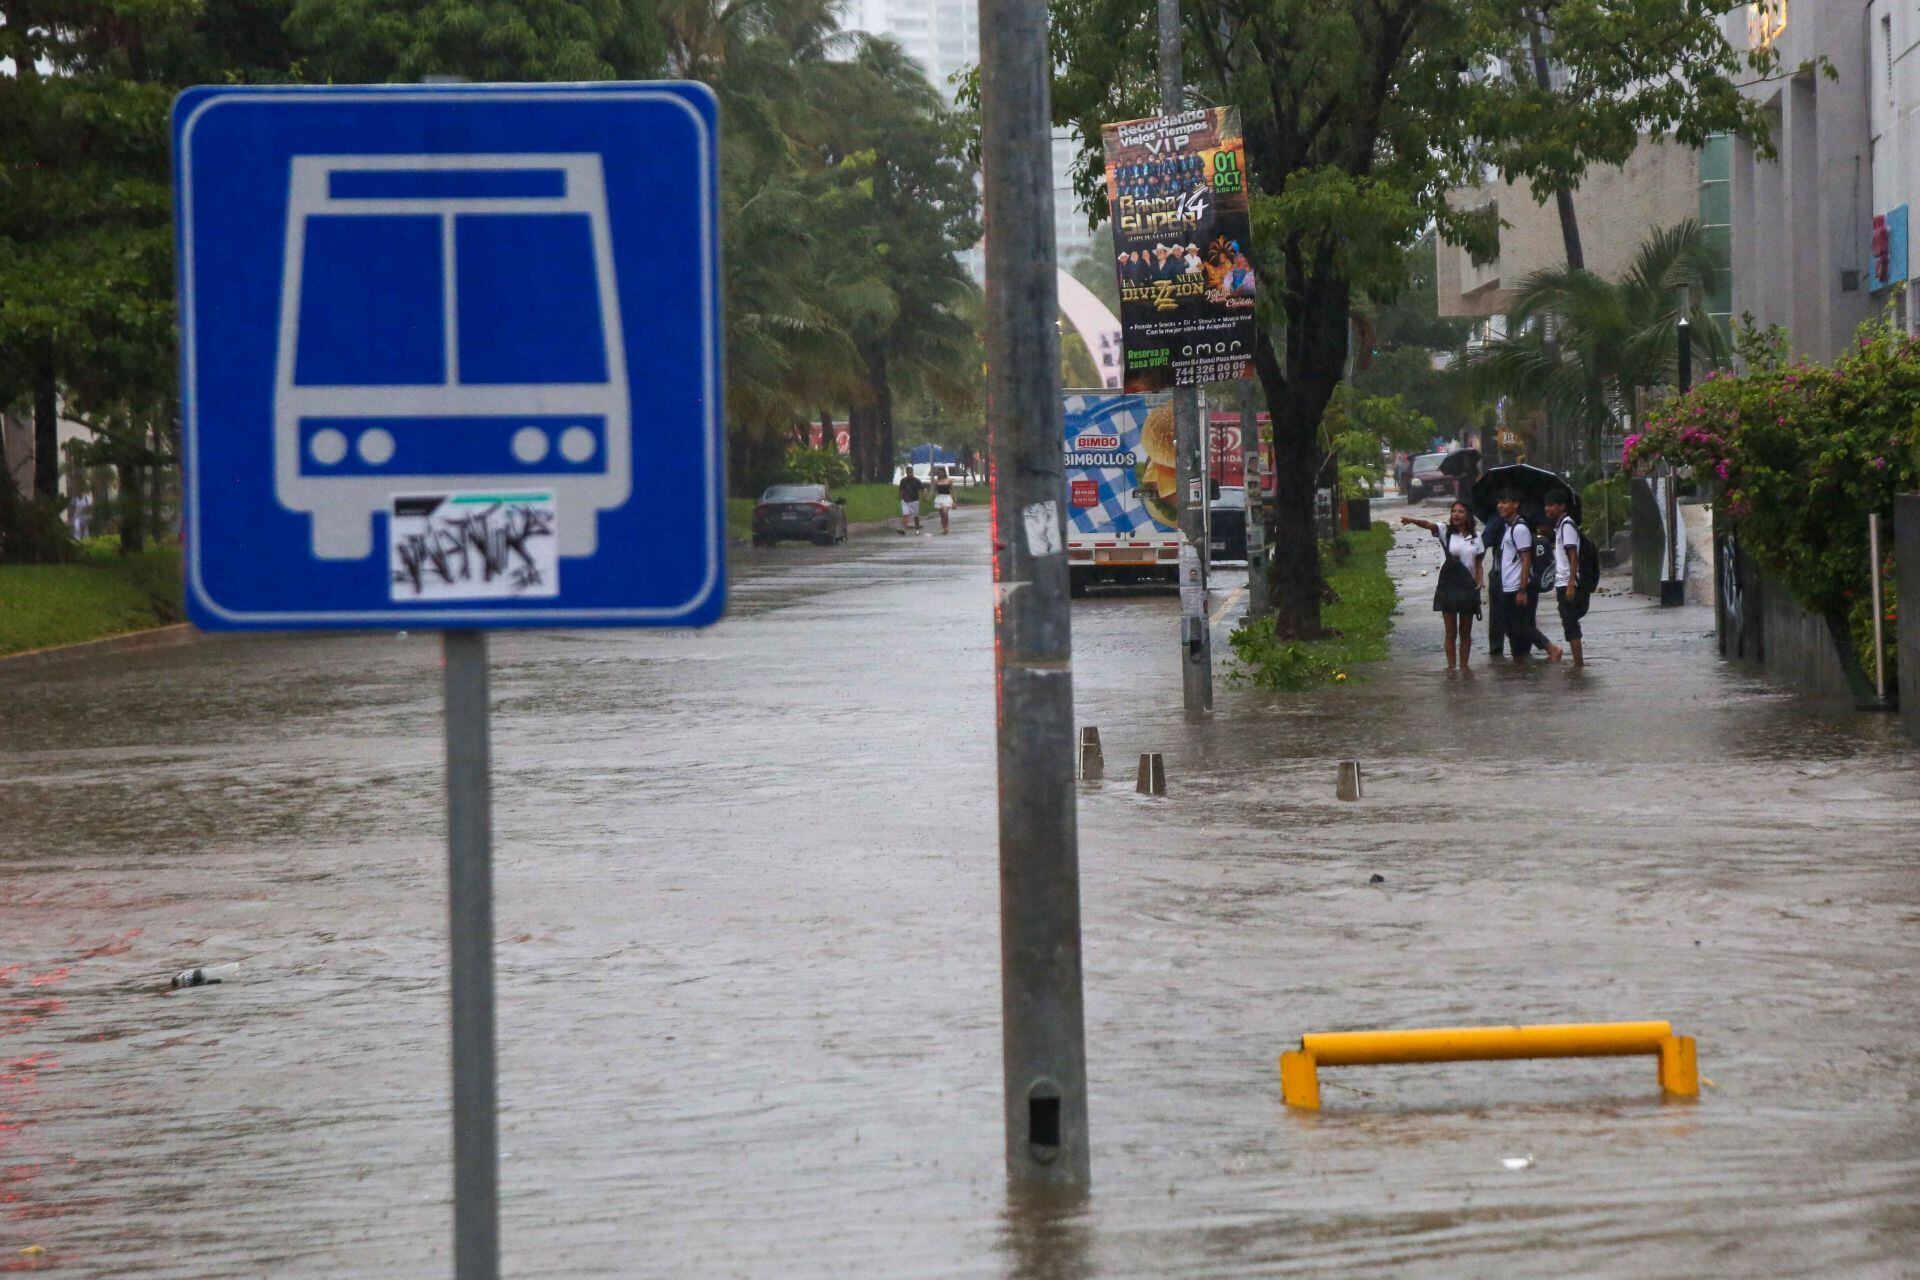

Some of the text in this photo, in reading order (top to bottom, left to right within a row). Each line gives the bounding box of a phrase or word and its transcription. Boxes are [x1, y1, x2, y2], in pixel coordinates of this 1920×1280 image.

[1118, 110, 1206, 138] Recordando
[1121, 121, 1208, 147] Viejos Tiempos
[1145, 135, 1190, 155] VIP
[1215, 151, 1236, 172] 01
[1214, 171, 1241, 186] OCT
[1176, 187, 1210, 220] 14
[1121, 211, 1198, 234] SUPER
[1128, 348, 1170, 359] Reserva ya
[1182, 340, 1242, 356] amar
[1130, 357, 1168, 368] zona VIP!!
[1176, 361, 1246, 376] 744 326 00 06
[1176, 370, 1245, 386] 744 204 07 07
[1078, 438, 1118, 446] BIMBO
[1064, 453, 1134, 466] BIMBOLLOS
[1211, 454, 1243, 462] LANDA
